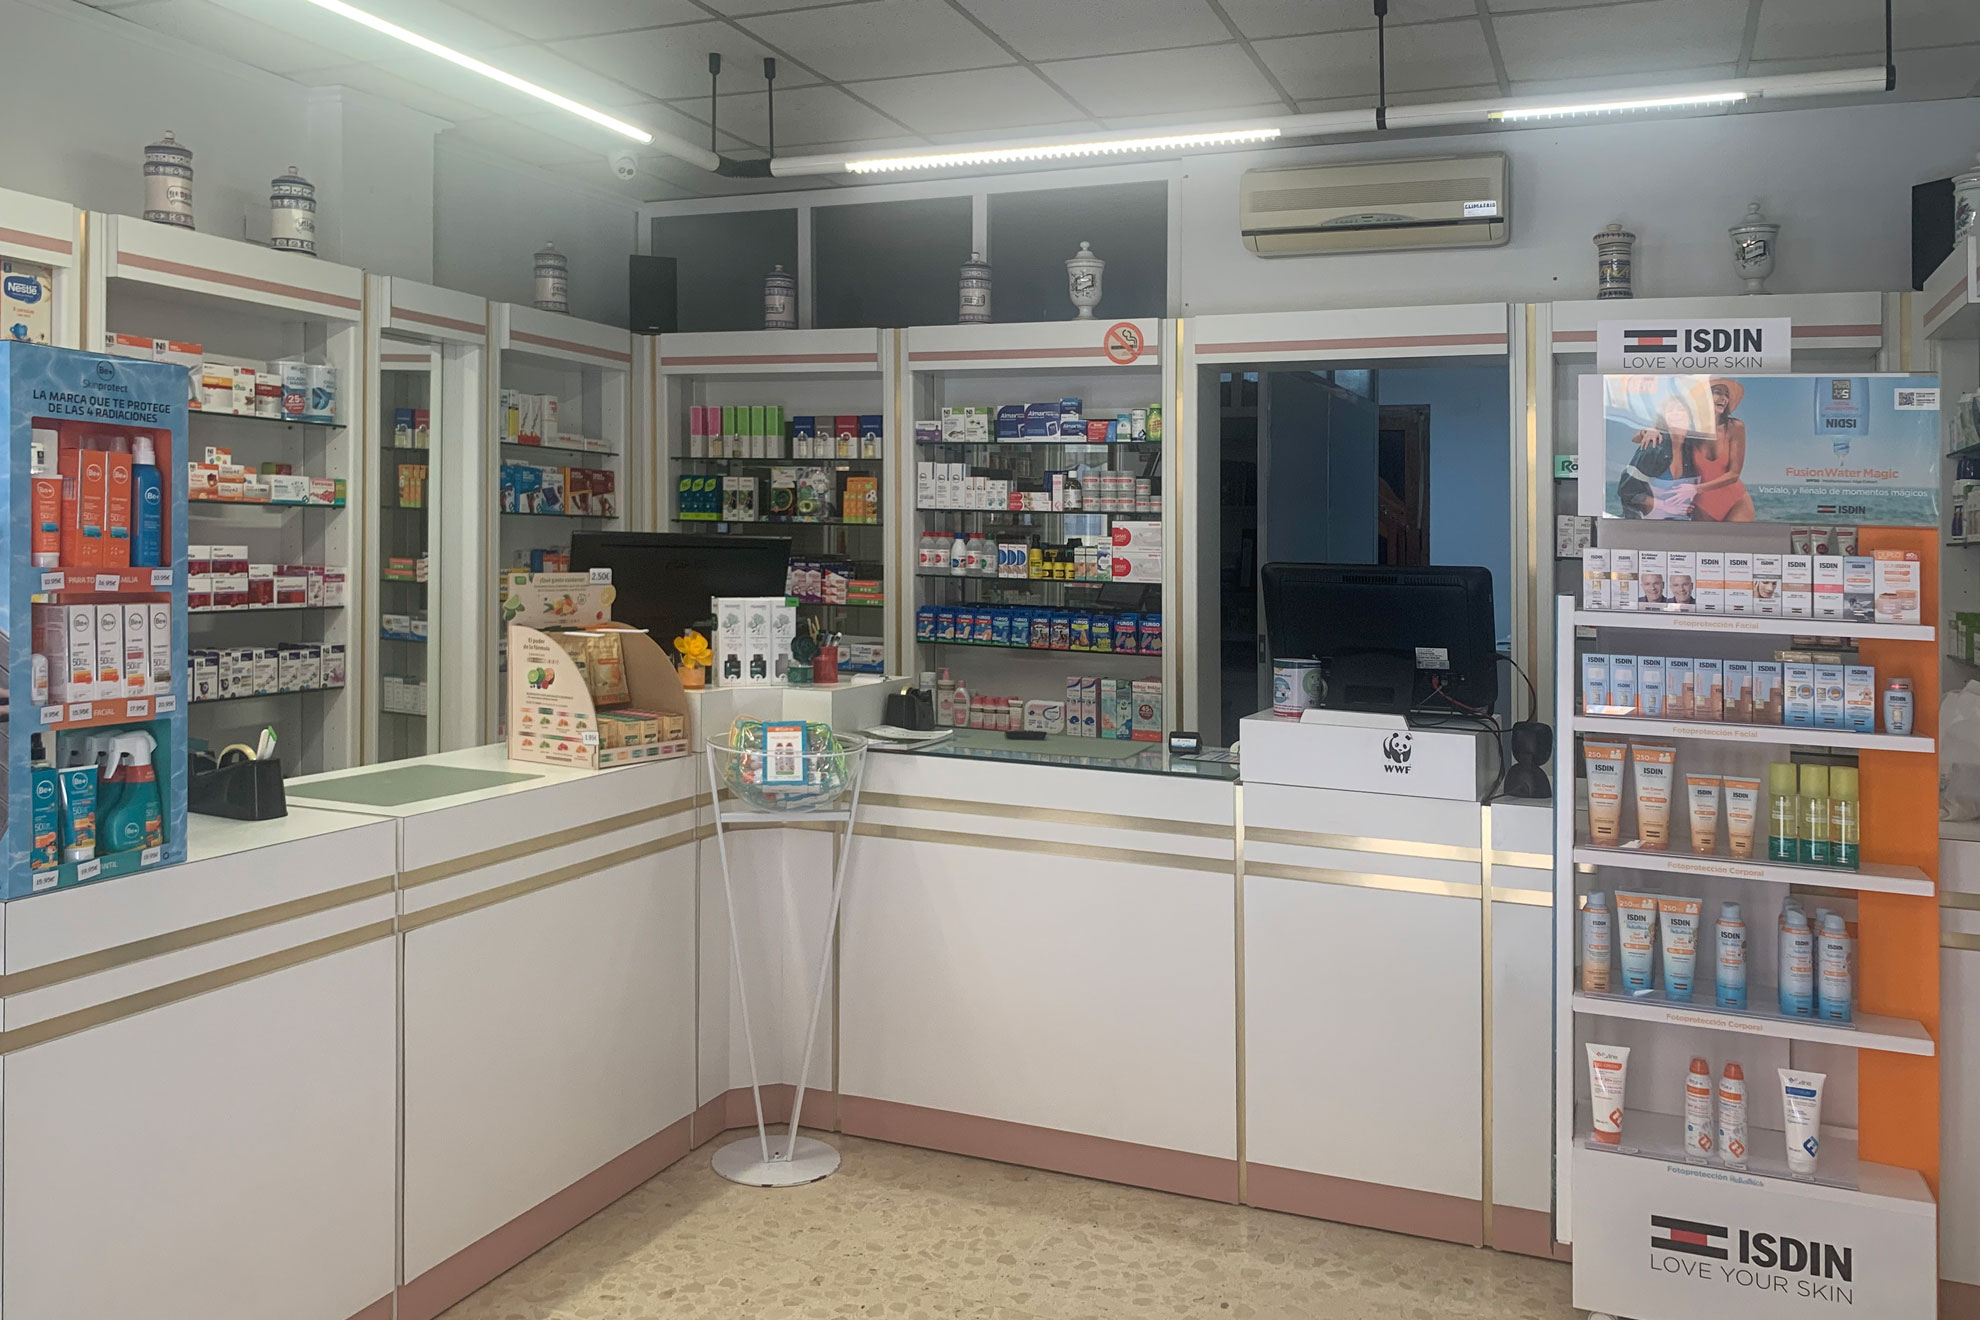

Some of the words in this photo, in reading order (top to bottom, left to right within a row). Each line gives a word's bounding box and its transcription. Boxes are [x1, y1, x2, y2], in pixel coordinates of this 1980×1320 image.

[1684, 328, 1763, 353] ISDIN
[1623, 356, 1666, 369] LOVE
[1671, 356, 1719, 369] YOUR
[1724, 356, 1763, 369] SKIN
[82, 378, 129, 393] Skinprotect
[33, 389, 47, 401] LA
[49, 391, 87, 406] MARCA
[89, 395, 110, 408] QUE
[112, 398, 125, 409] TE
[127, 400, 171, 414] PROTEGE
[48, 402, 63, 413] DE
[65, 404, 85, 416] LAS
[86, 407, 94, 417] 4
[95, 407, 158, 424] RADIACIONES
[1825, 418, 1857, 429] ISDIN
[1863, 467, 1899, 480] Magic
[1758, 485, 1791, 495] Vacíalo,
[1792, 488, 1798, 496] y
[1799, 486, 1827, 496] llénalo
[1829, 487, 1841, 496] de
[1842, 488, 1889, 497] momentos
[1890, 488, 1928, 499] mágicos
[1838, 504, 1866, 515] ISDIN
[1701, 558, 1720, 566] ISDIN
[1729, 559, 1748, 567] ISDIN
[120, 575, 138, 584] MILIA
[1673, 618, 1734, 629] Fotoprotección
[1735, 621, 1759, 630] Facial
[1587, 656, 1605, 664] ISDIN
[1615, 657, 1633, 665] ISDIN
[1643, 658, 1661, 666] ISDIN
[1670, 660, 1689, 668] ISDIN
[1698, 661, 1717, 669] ISDIN
[1728, 663, 1747, 671] ISDIN
[1757, 664, 1777, 672] ISDIN
[1672, 725, 1733, 738] Fotoprotección
[1734, 730, 1758, 739] Facial
[1384, 764, 1412, 775] WWF
[1595, 763, 1615, 772] ISDIN
[1643, 767, 1664, 775] ISDIN
[1697, 789, 1713, 797] ISDIN
[1732, 791, 1749, 799] ISDIN
[1667, 860, 1728, 874] Fotoprotección
[1729, 866, 1765, 878] Corporal
[1620, 900, 1633, 908] 250
[1663, 904, 1677, 912] 250
[1627, 913, 1647, 922] ISDIN
[1670, 918, 1691, 927] ISDIN
[1721, 931, 1741, 940] ISDIN
[1827, 943, 1844, 951] ISDIN
[1666, 1012, 1727, 1029] Fotoprotección
[1727, 1019, 1764, 1032] Corporal
[1667, 1164, 1729, 1182] Fotoprotección
[1739, 1229, 1852, 1282] ISDIN
[1650, 1253, 1712, 1280] LOVE
[1720, 1265, 1789, 1294] YOUR
[1797, 1279, 1853, 1305] SKIN
